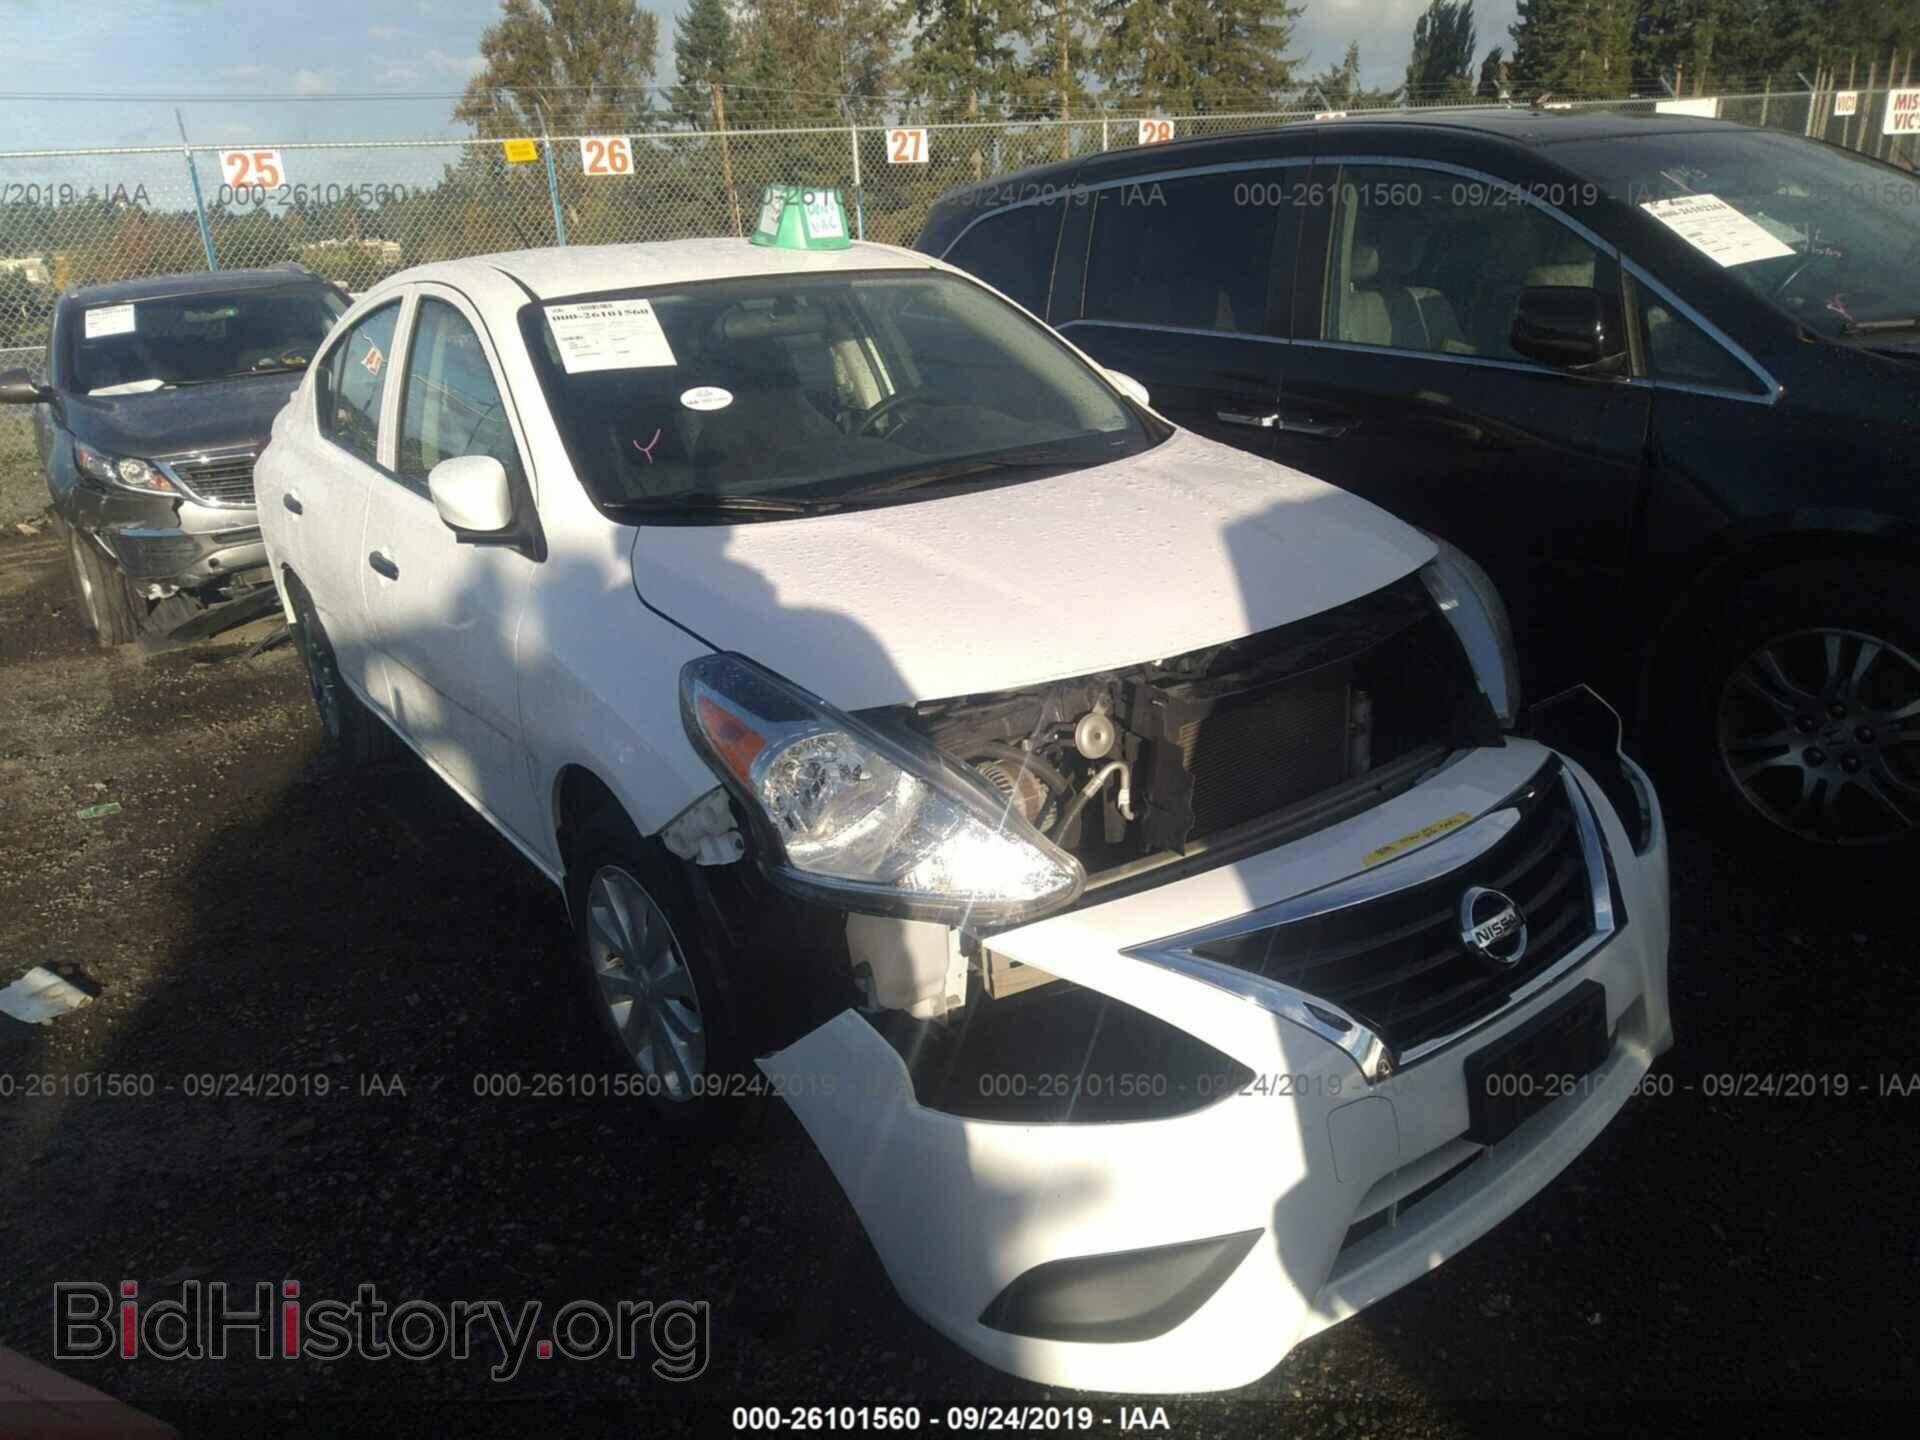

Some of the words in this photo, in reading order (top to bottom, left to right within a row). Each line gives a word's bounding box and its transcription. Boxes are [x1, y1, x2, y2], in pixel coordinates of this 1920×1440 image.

[892, 131, 921, 161] 27
[1143, 122, 1170, 143] 28
[226, 152, 279, 189] 25
[585, 139, 628, 173] 26
